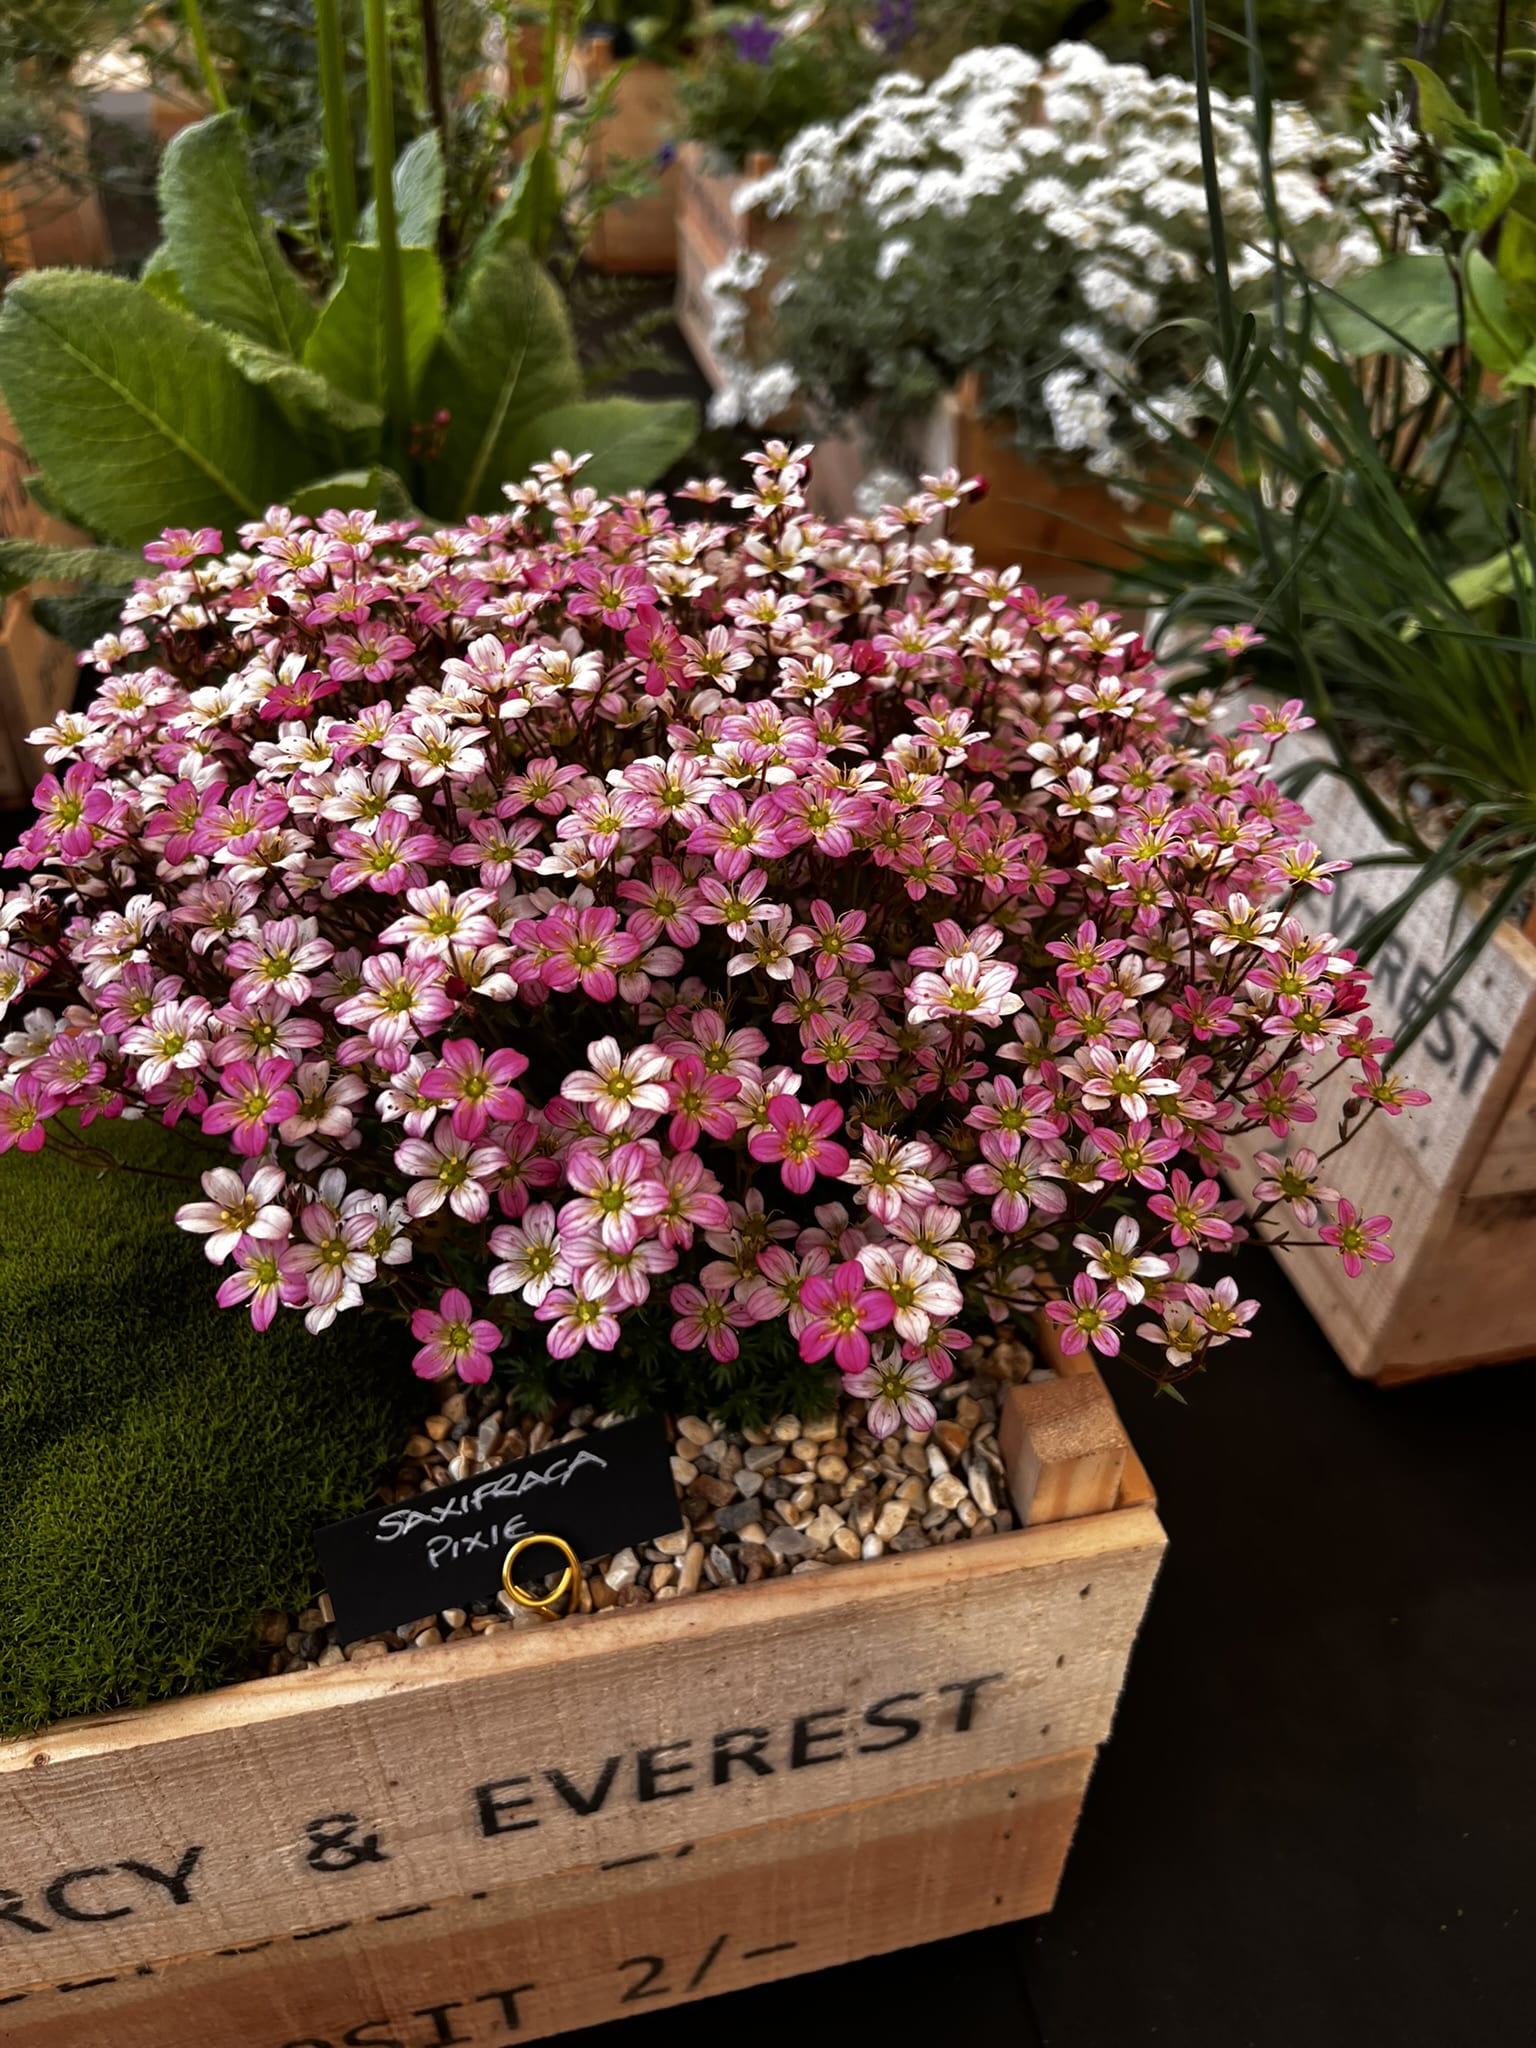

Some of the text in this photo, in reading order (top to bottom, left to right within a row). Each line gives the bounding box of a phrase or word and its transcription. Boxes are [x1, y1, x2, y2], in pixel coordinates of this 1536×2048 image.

[426, 1514, 534, 1568] PIXIE
[306, 1812, 391, 1872] &
[473, 1673, 1004, 1837] EVEREST
[617, 1933, 798, 2003] 2/-
